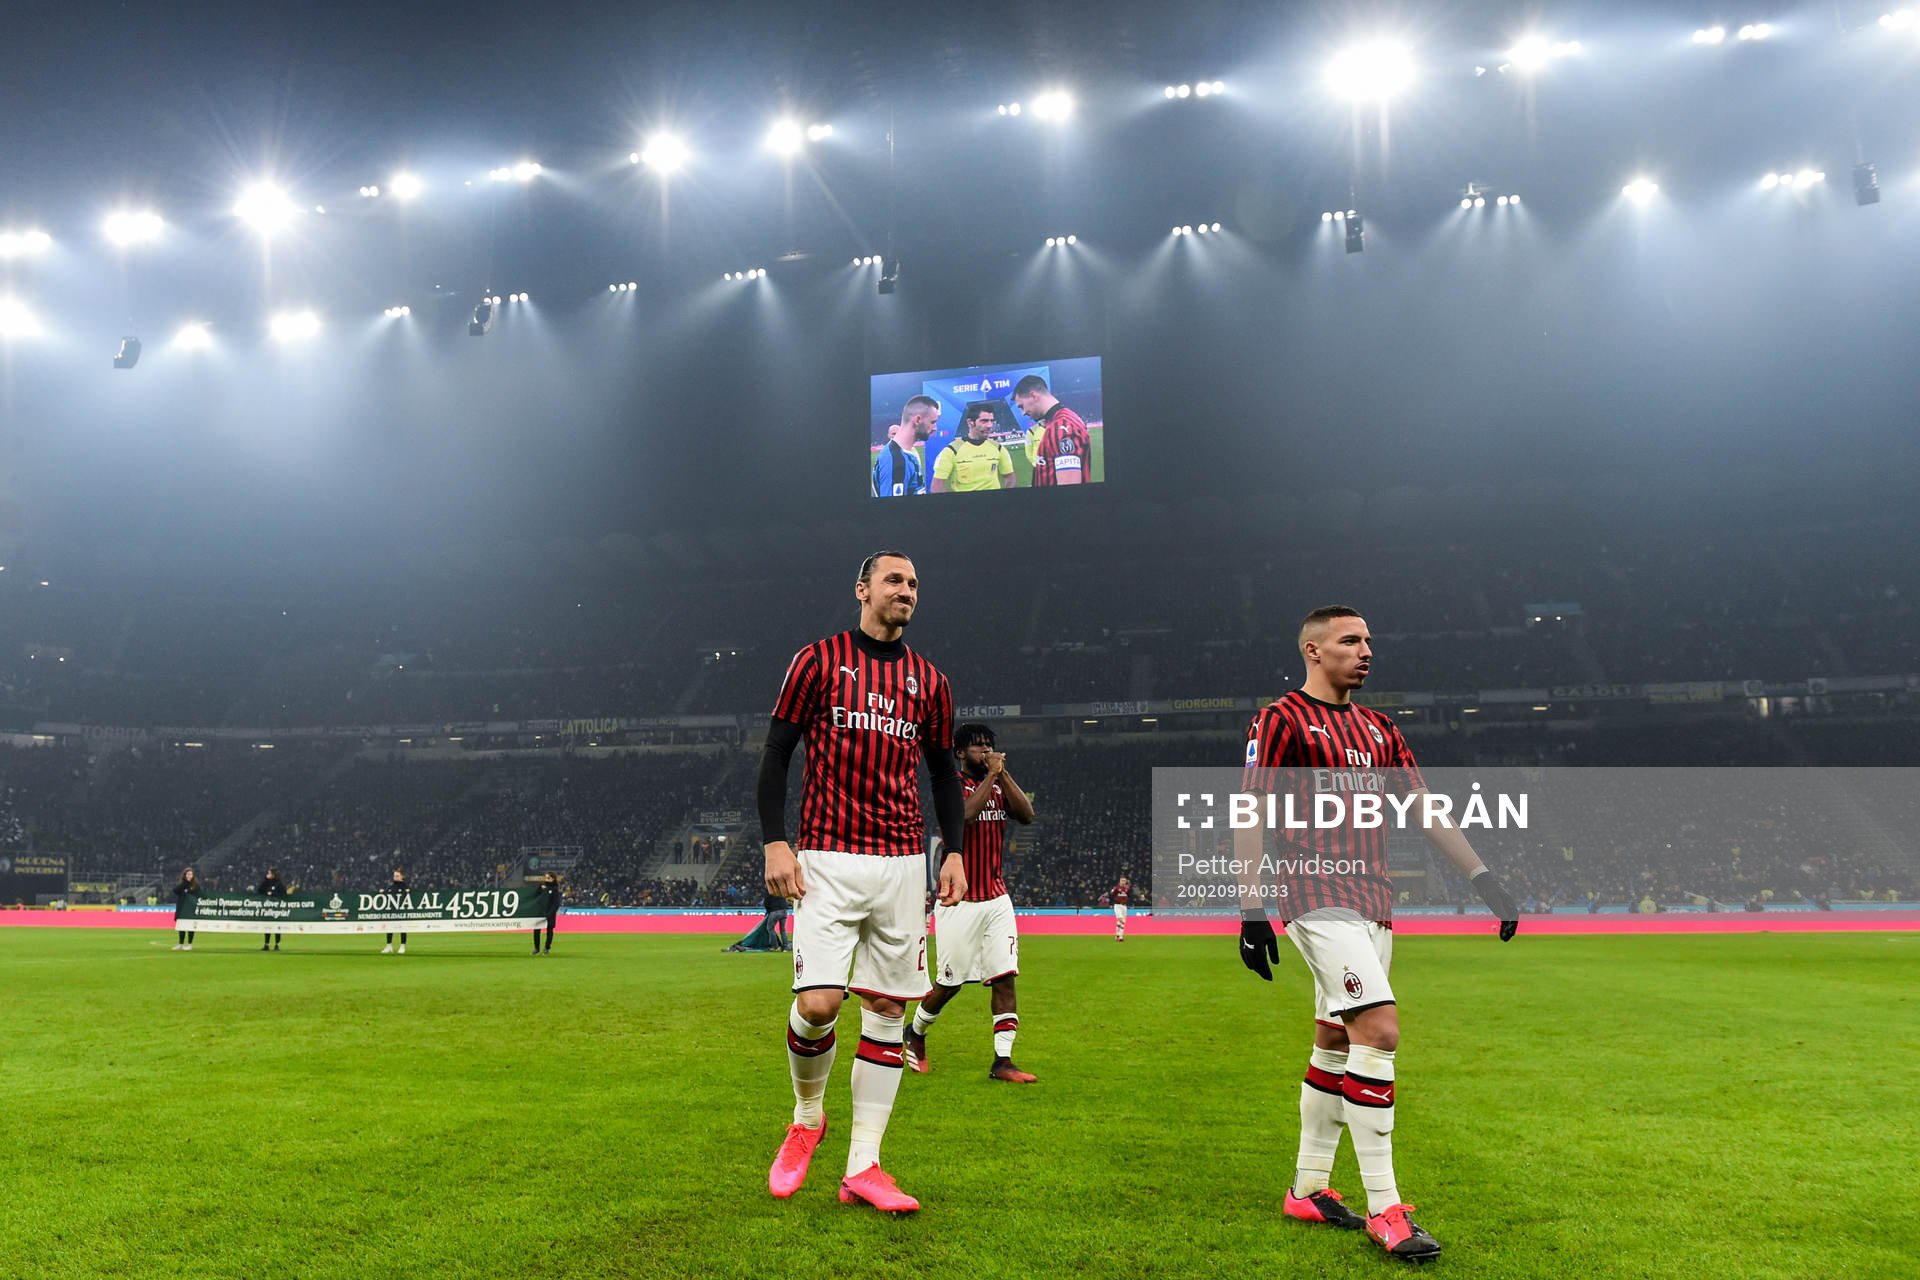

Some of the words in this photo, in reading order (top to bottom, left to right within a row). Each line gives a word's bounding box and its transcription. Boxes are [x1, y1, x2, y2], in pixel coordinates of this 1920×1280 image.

[953, 383, 978, 393] SERIE
[993, 379, 1010, 389] TIM
[868, 692, 894, 714] Fly
[1174, 698, 1235, 709] GIORGIONE
[832, 706, 918, 739] Emirates
[1345, 748, 1371, 769] Fly
[218, 898, 242, 908] Dynamo
[263, 899, 279, 908] dove
[280, 900, 287, 908] la
[301, 900, 315, 908] cura
[358, 893, 414, 911] DONA
[417, 892, 443, 910] AL
[446, 890, 520, 919] 45519
[229, 908, 254, 917] medicina
[407, 911, 442, 919] PERMANENTE
